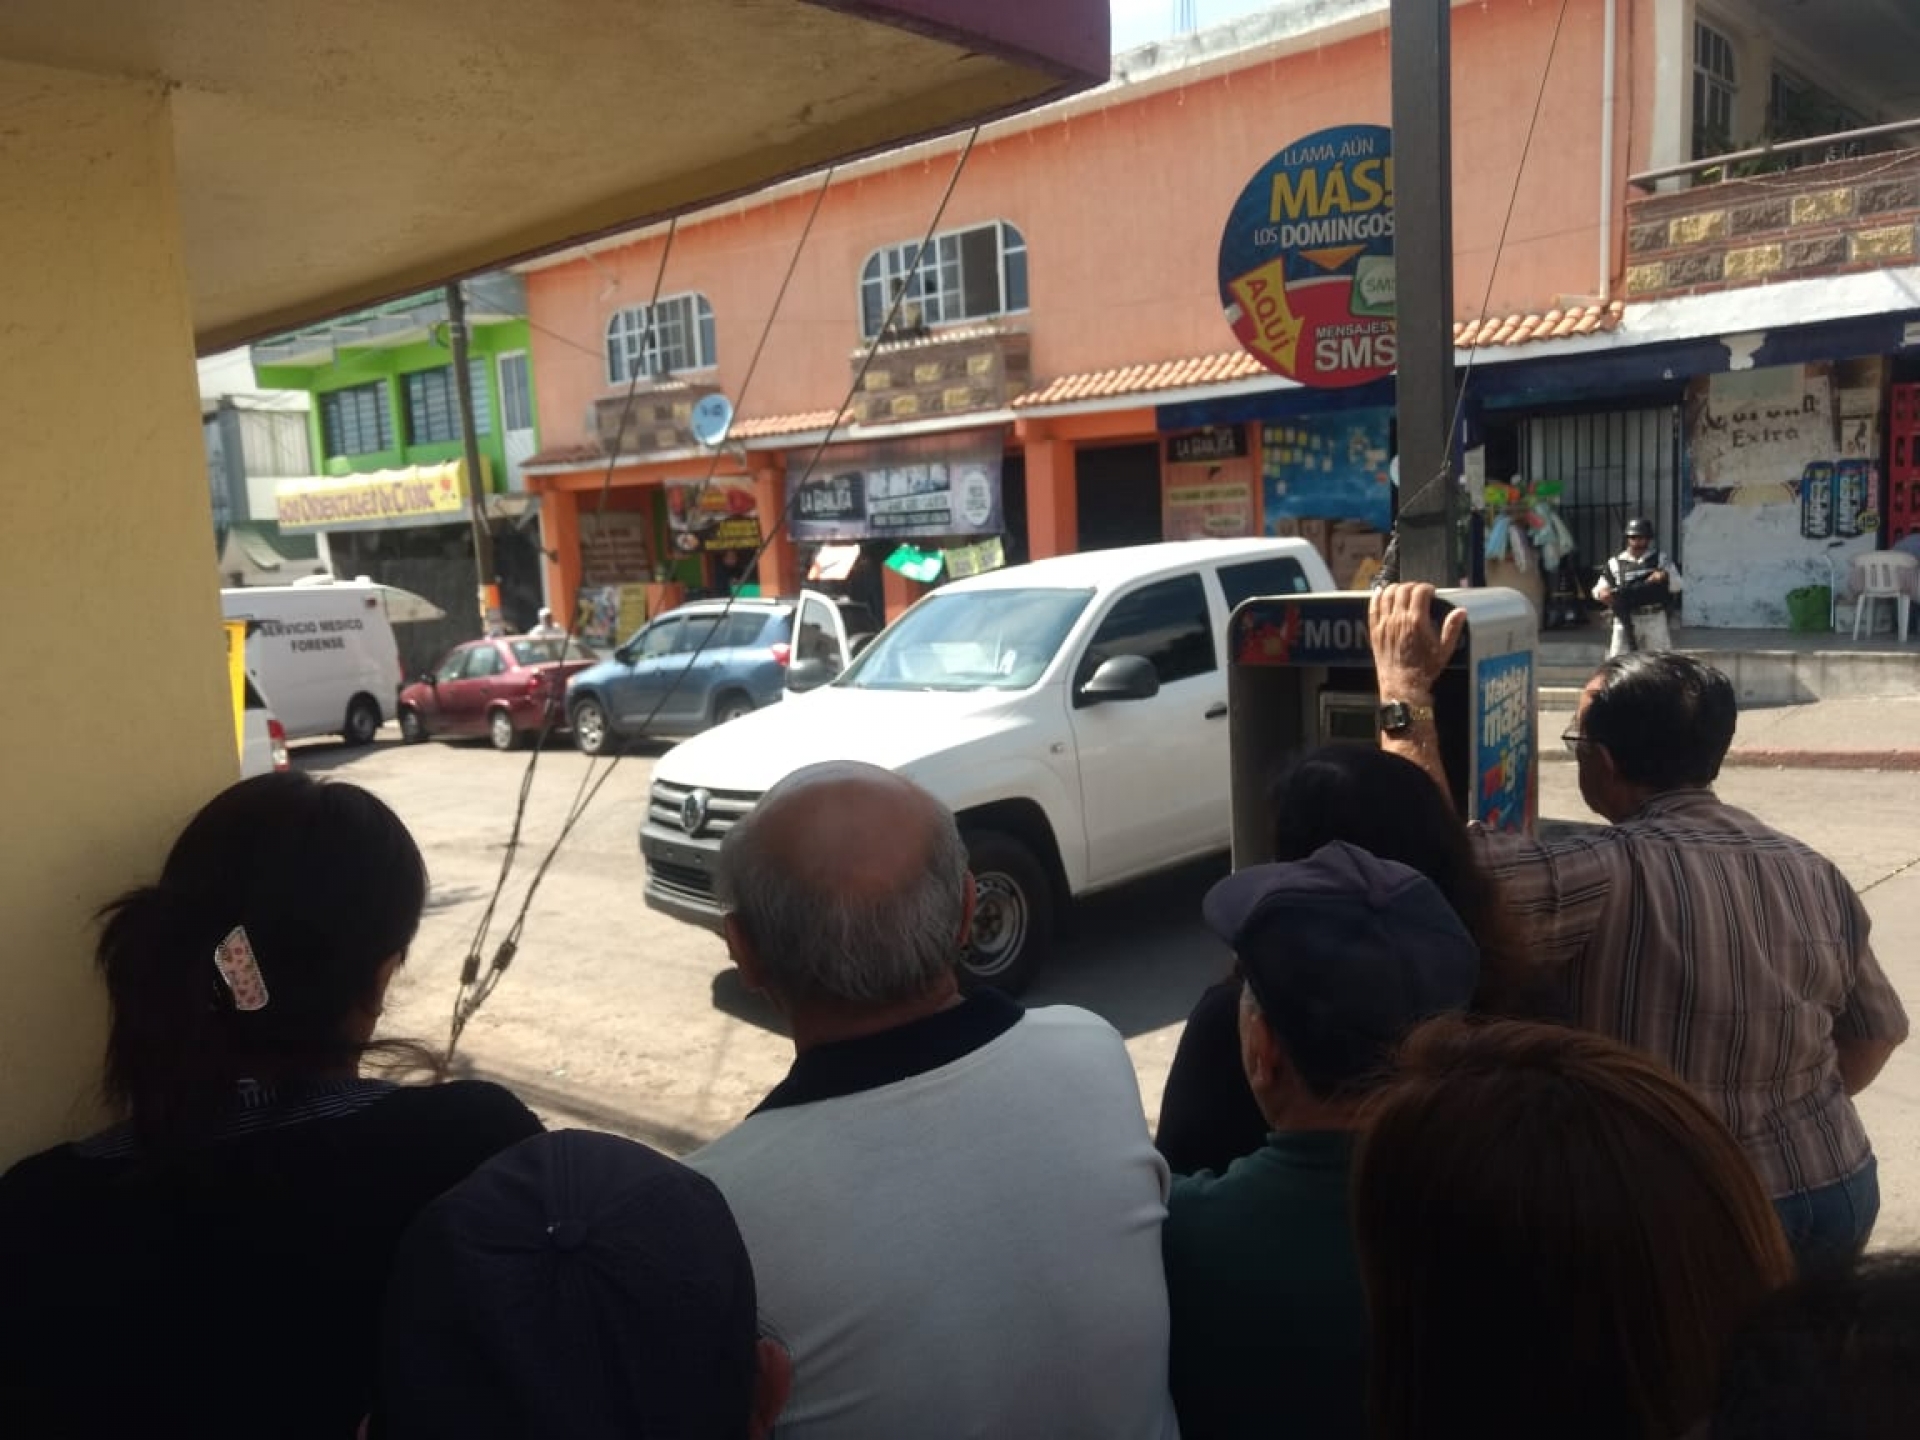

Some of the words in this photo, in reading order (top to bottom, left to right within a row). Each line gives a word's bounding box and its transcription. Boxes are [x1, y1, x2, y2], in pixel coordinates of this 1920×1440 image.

[1284, 144, 1335, 165] LLAMA
[1339, 136, 1374, 156] AÚN
[1270, 157, 1395, 223] MÁS!
[1254, 226, 1278, 245] LOS
[1281, 213, 1396, 248] DOMINGOS
[1366, 276, 1396, 294] SM
[1315, 321, 1389, 338] MENSAJES
[1315, 334, 1397, 371] SMS
[260, 620, 317, 637] SERVICIO
[319, 618, 363, 632] MEDICO
[290, 637, 345, 652] FORENSE
